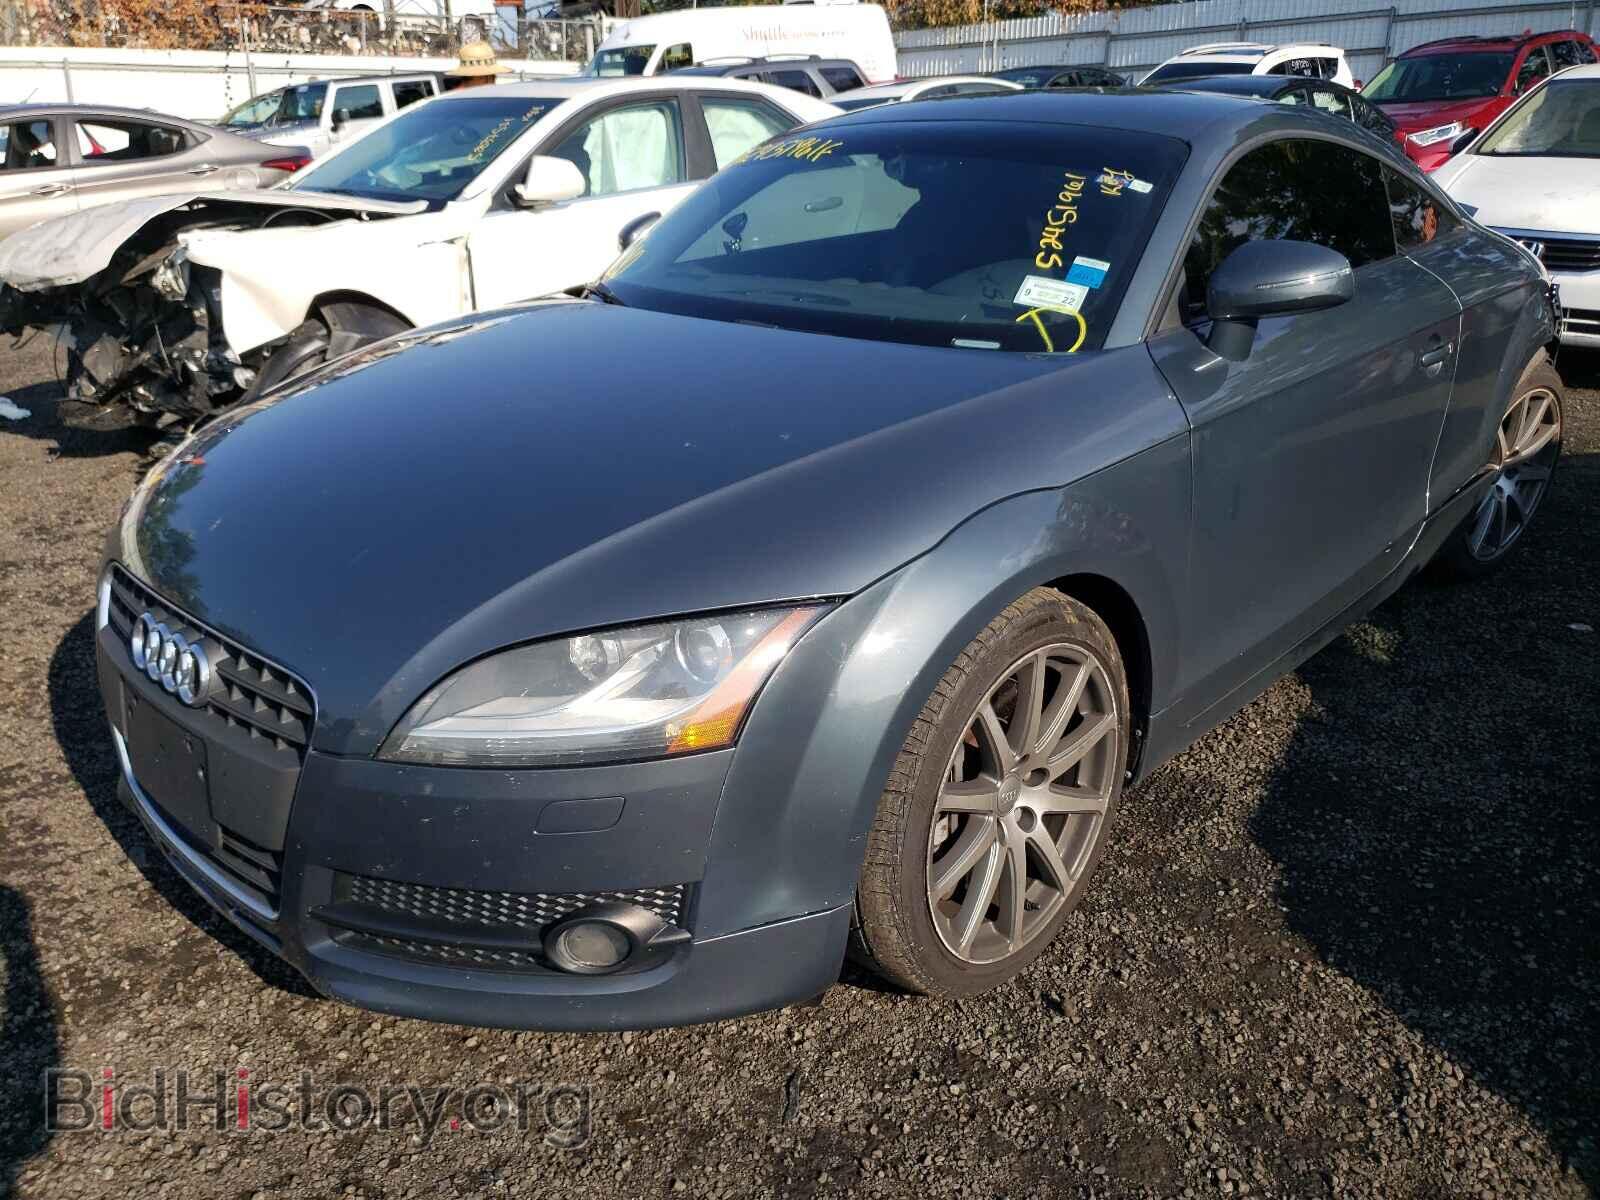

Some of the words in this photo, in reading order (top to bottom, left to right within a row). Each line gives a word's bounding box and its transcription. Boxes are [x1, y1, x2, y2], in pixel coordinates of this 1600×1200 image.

[1035, 172, 1086, 269] 52451961
[1024, 287, 1032, 297] 9
[1061, 296, 1076, 306] 22
